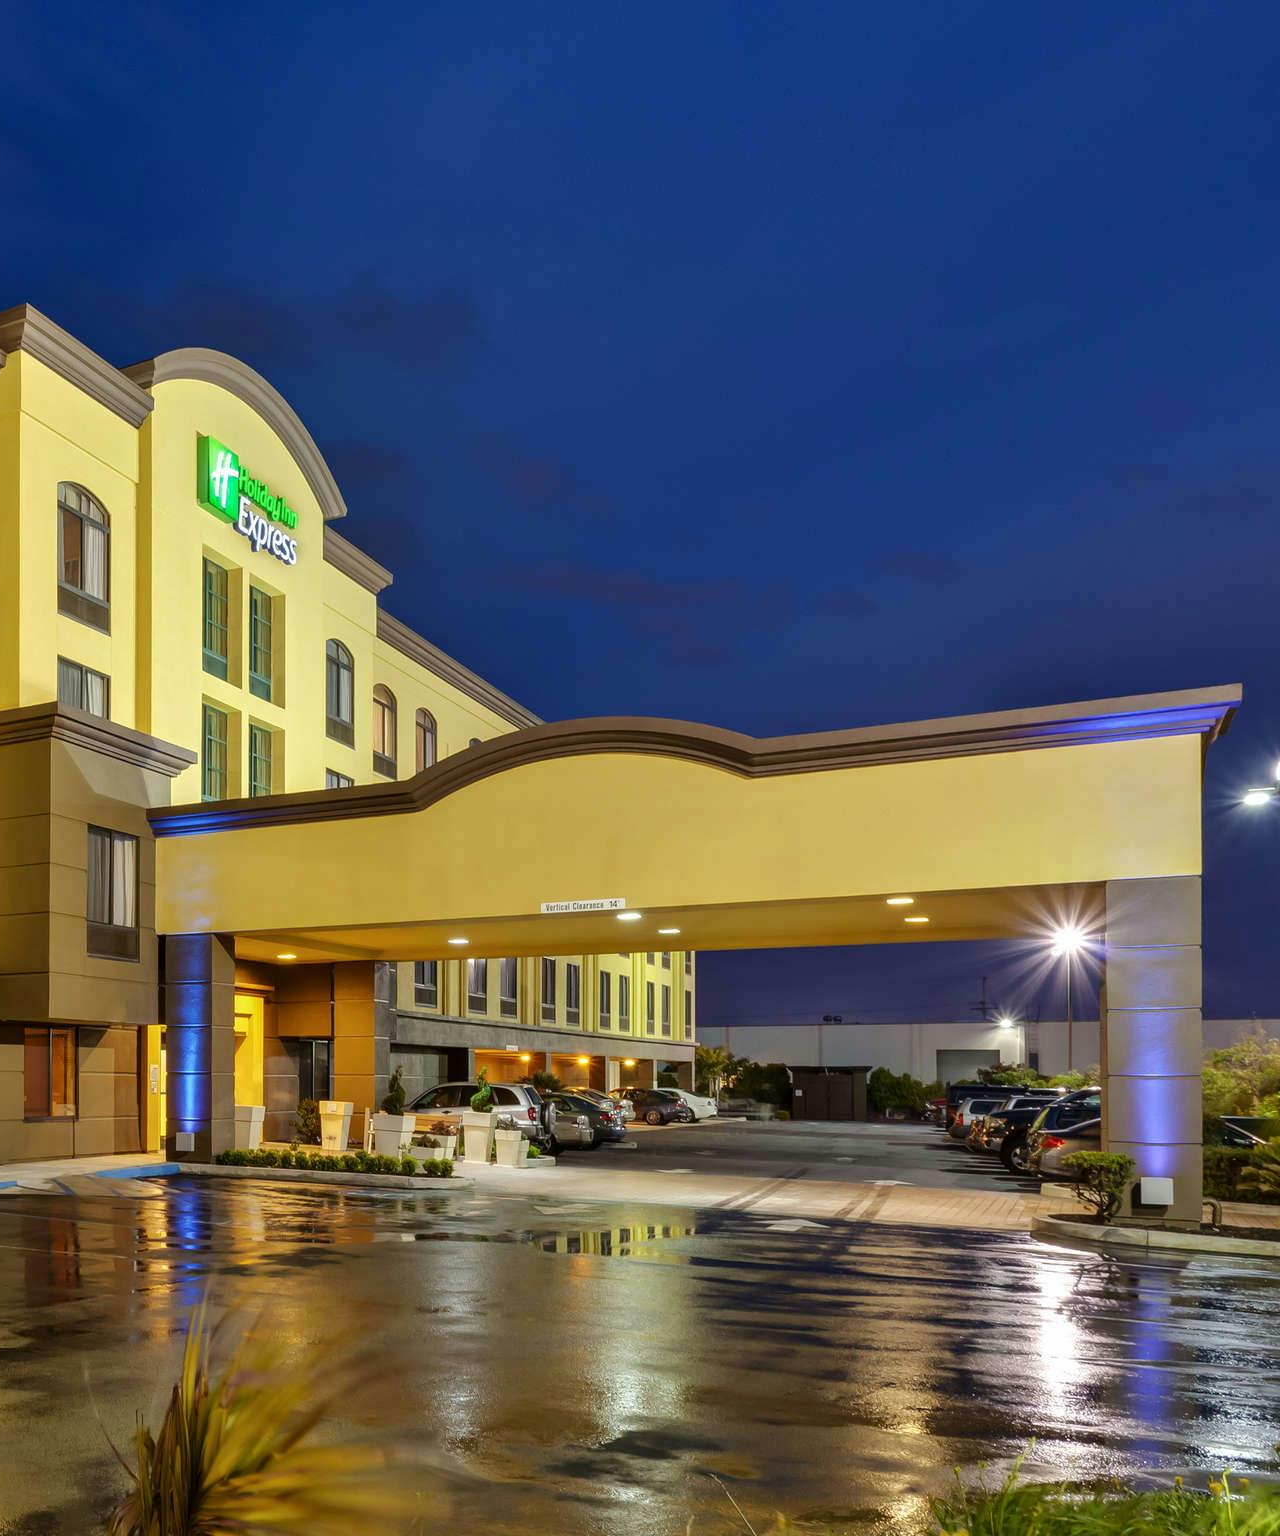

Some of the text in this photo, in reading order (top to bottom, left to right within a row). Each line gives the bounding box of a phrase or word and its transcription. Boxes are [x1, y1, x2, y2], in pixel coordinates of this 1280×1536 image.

[239, 466, 298, 529] Holiday Inn
[238, 496, 297, 565] Express
[546, 903, 570, 912] Vertical
[572, 902, 604, 911] Clearance
